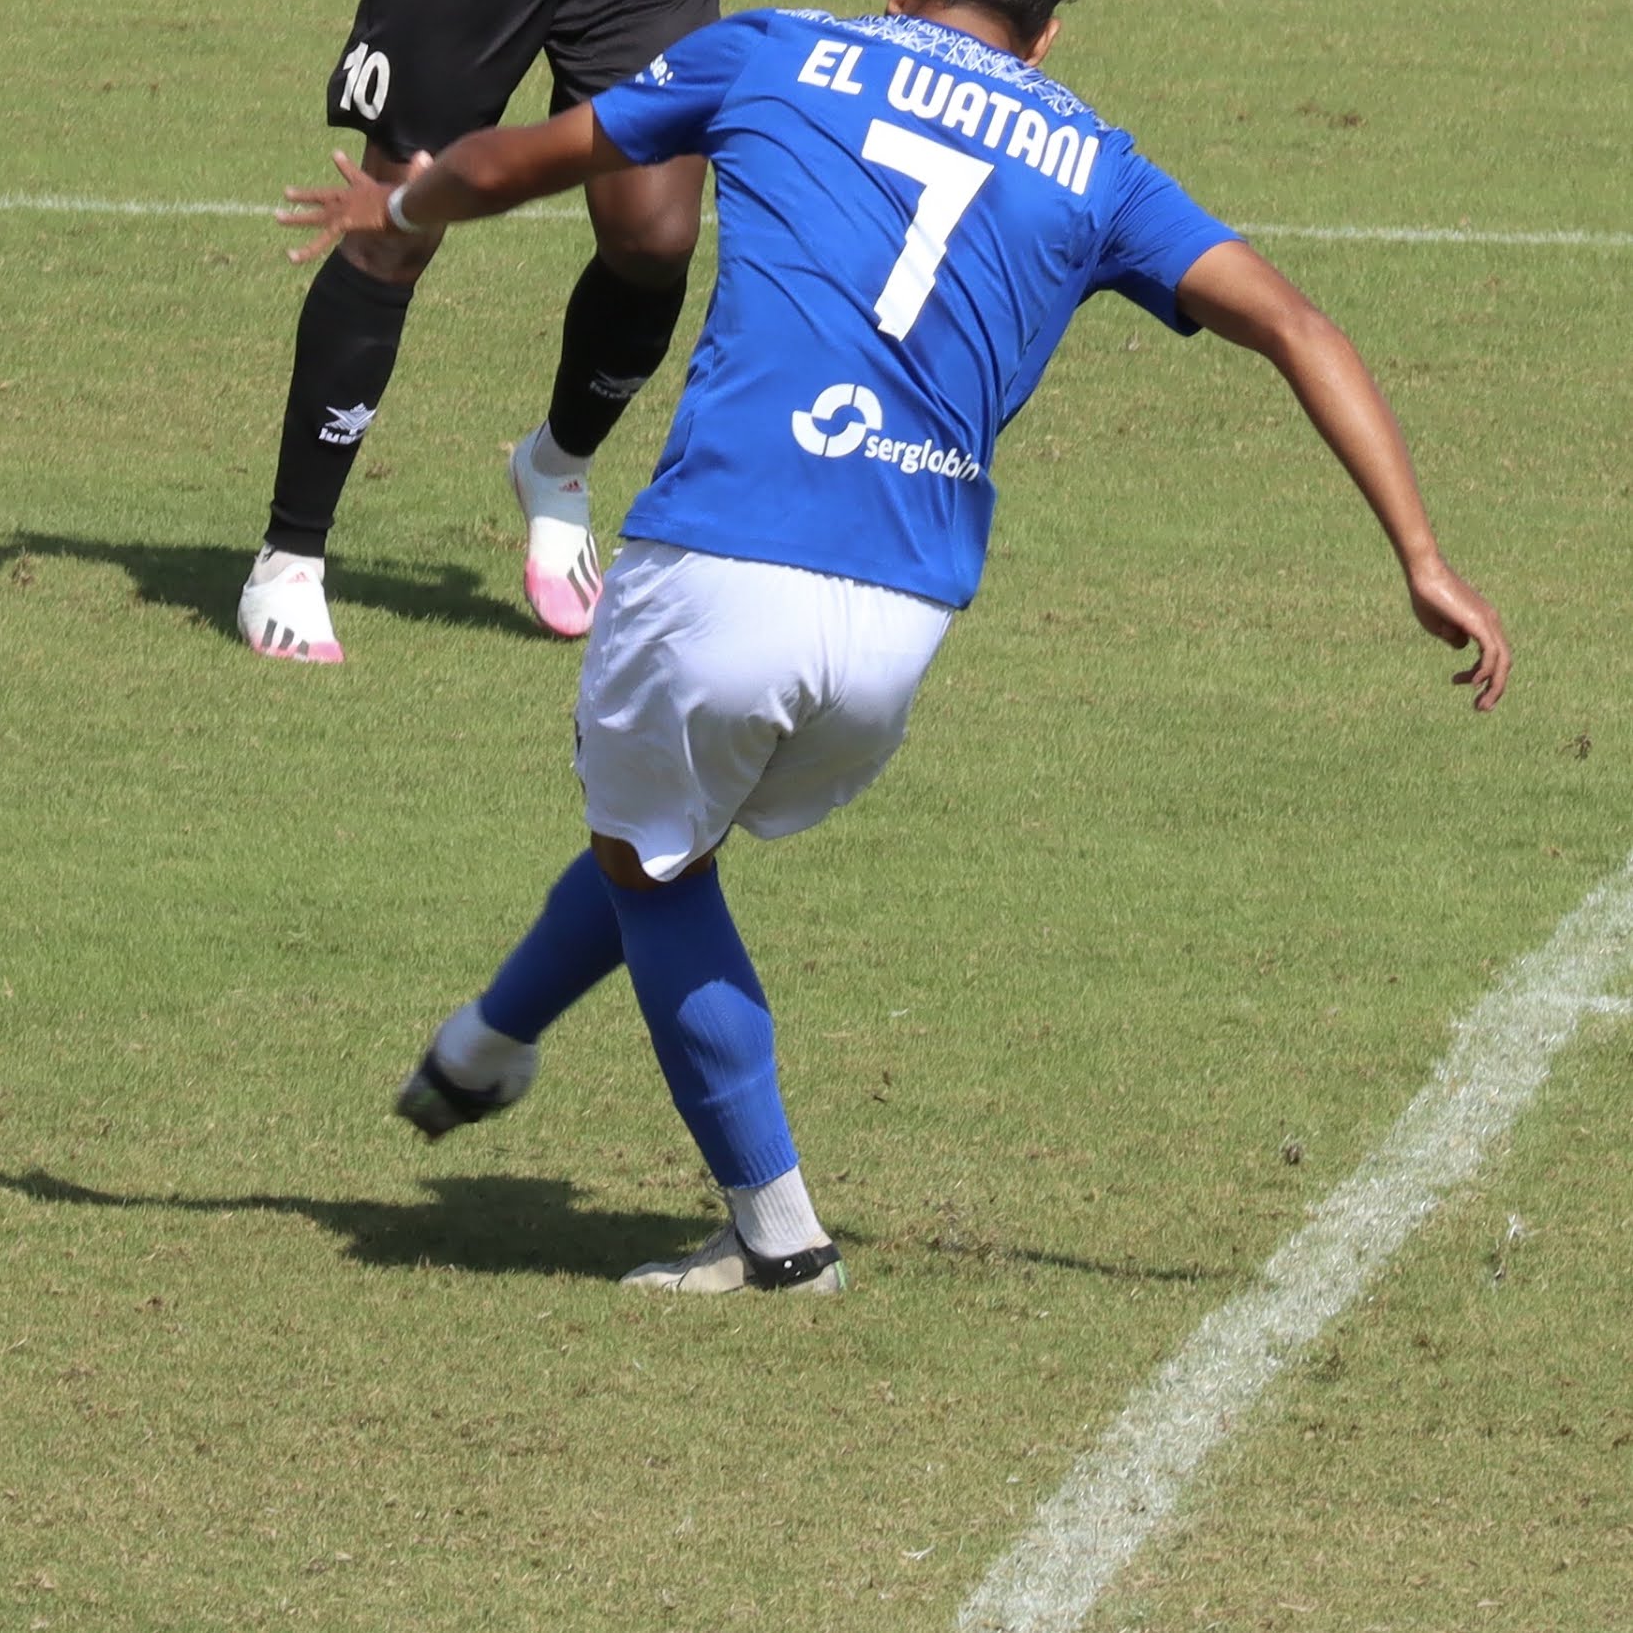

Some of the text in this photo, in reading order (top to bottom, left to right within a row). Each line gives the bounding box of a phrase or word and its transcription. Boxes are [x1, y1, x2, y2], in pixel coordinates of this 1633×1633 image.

[339, 41, 391, 121] 10
[797, 39, 1100, 195] EL WATANI
[861, 119, 995, 342] 7
